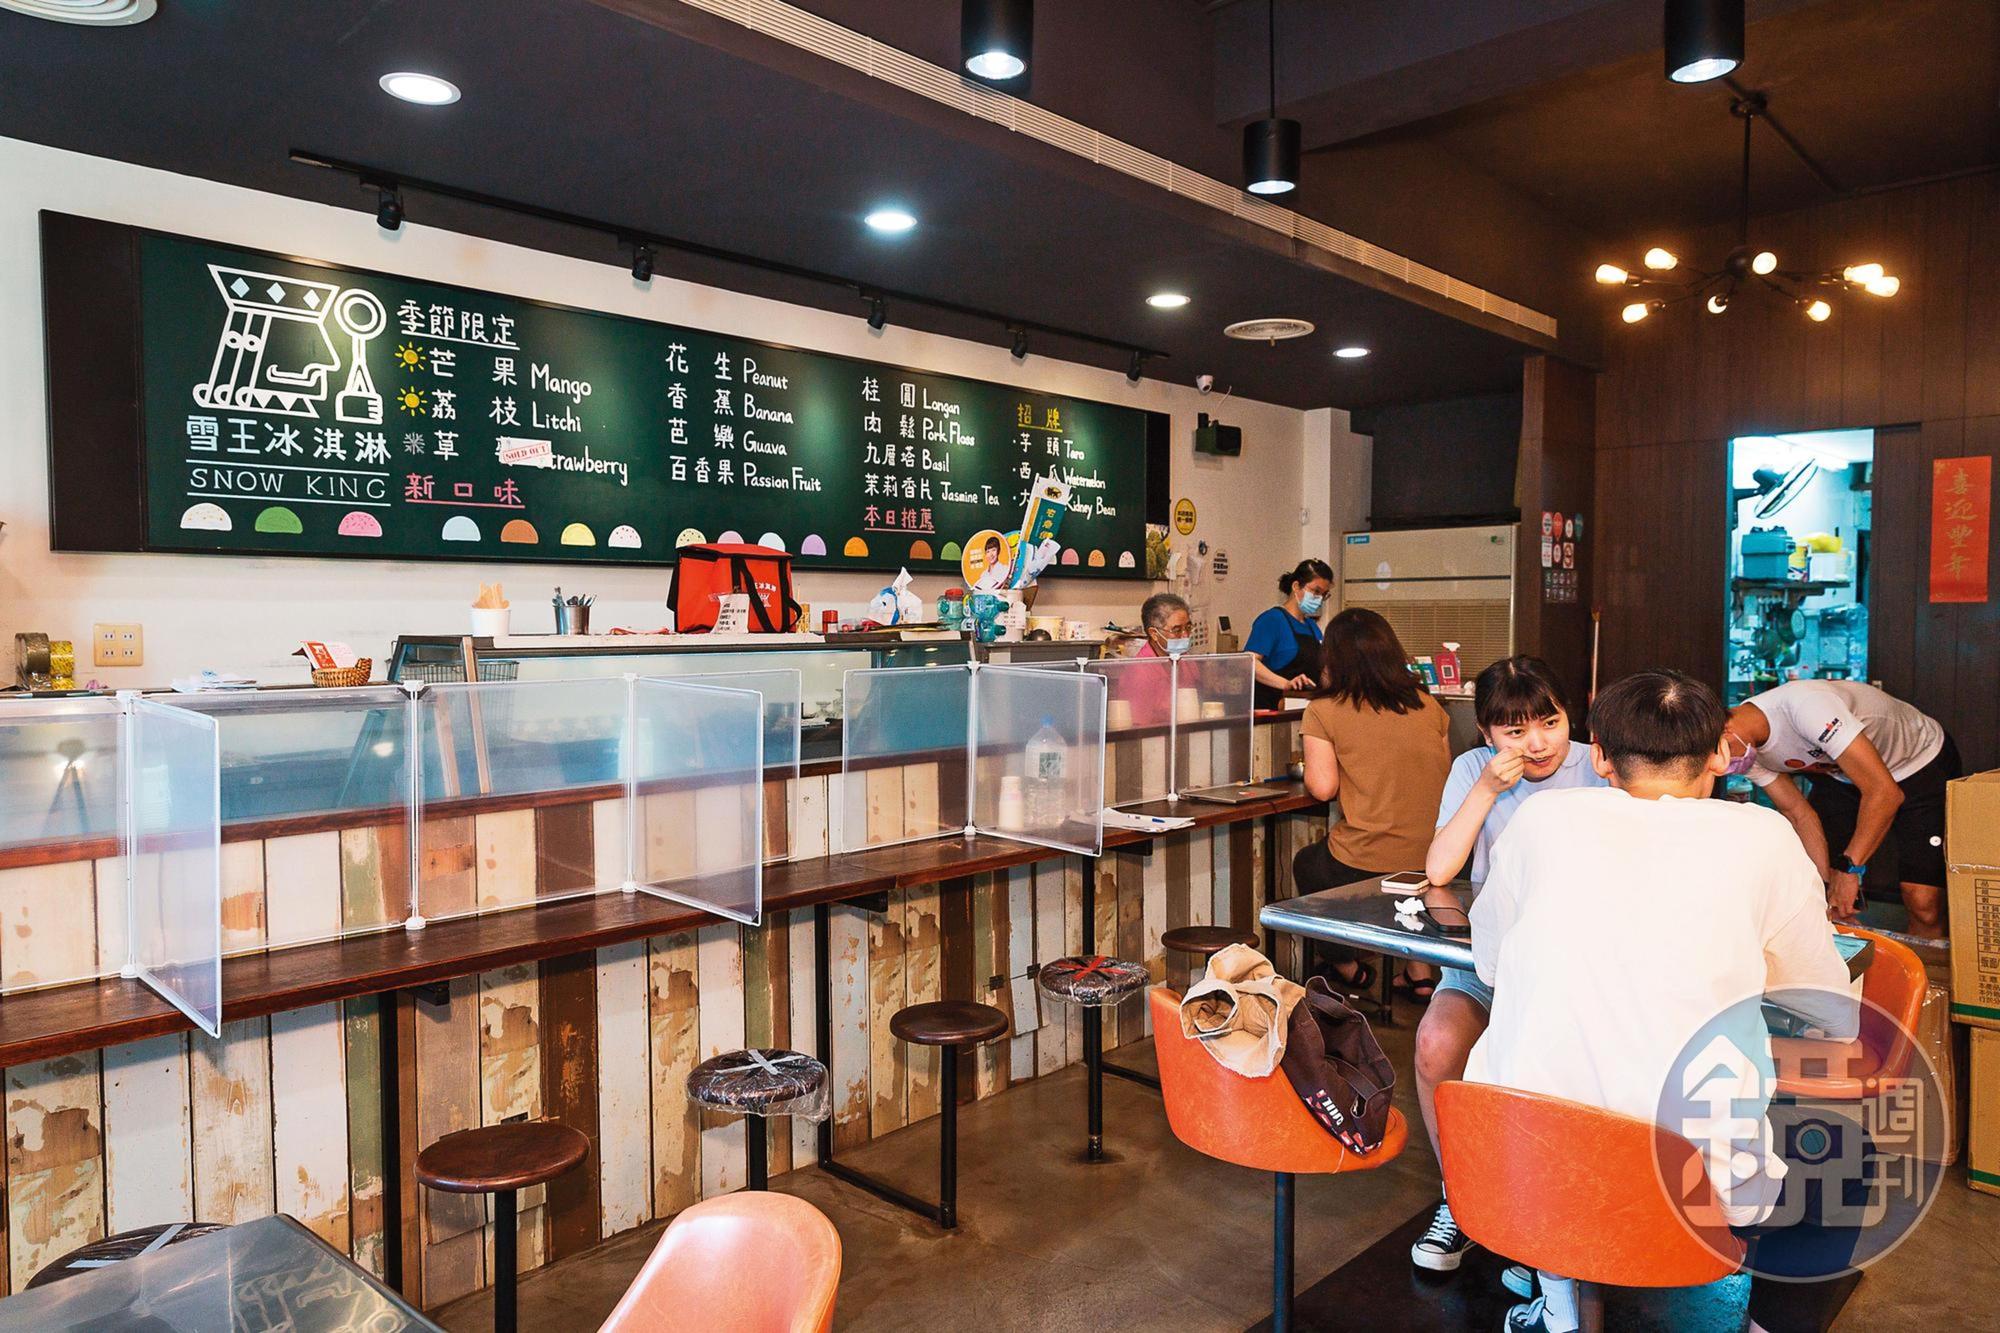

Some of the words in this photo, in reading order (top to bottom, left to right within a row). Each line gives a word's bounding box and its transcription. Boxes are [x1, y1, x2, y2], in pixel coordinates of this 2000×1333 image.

[397, 300, 516, 346] 季節限定
[531, 363, 592, 404] Mango
[743, 357, 789, 390] Peanut
[532, 401, 582, 432] Litchi
[743, 393, 794, 424] Banana
[923, 388, 960, 419] Longan
[186, 415, 391, 464] 雪王冰淇淋
[743, 431, 788, 456] Guava
[922, 417, 948, 443] Pork
[949, 421, 976, 447] Floss
[505, 448, 528, 460] SOLD
[863, 442, 916, 468] 九層塔
[922, 449, 950, 473] Basil
[1063, 439, 1085, 460] Taro
[538, 445, 628, 487] trawberry
[669, 455, 735, 485] 百香果
[743, 462, 789, 490] Passion
[791, 466, 822, 492] Fruit
[189, 468, 285, 493] SNOW
[306, 475, 386, 499] KING
[864, 473, 933, 500] 茉莉香片
[940, 481, 979, 504] Jasmine
[981, 485, 1000, 506] Tea
[863, 505, 935, 530] 本日推薦
[1096, 496, 1116, 516] Bean
